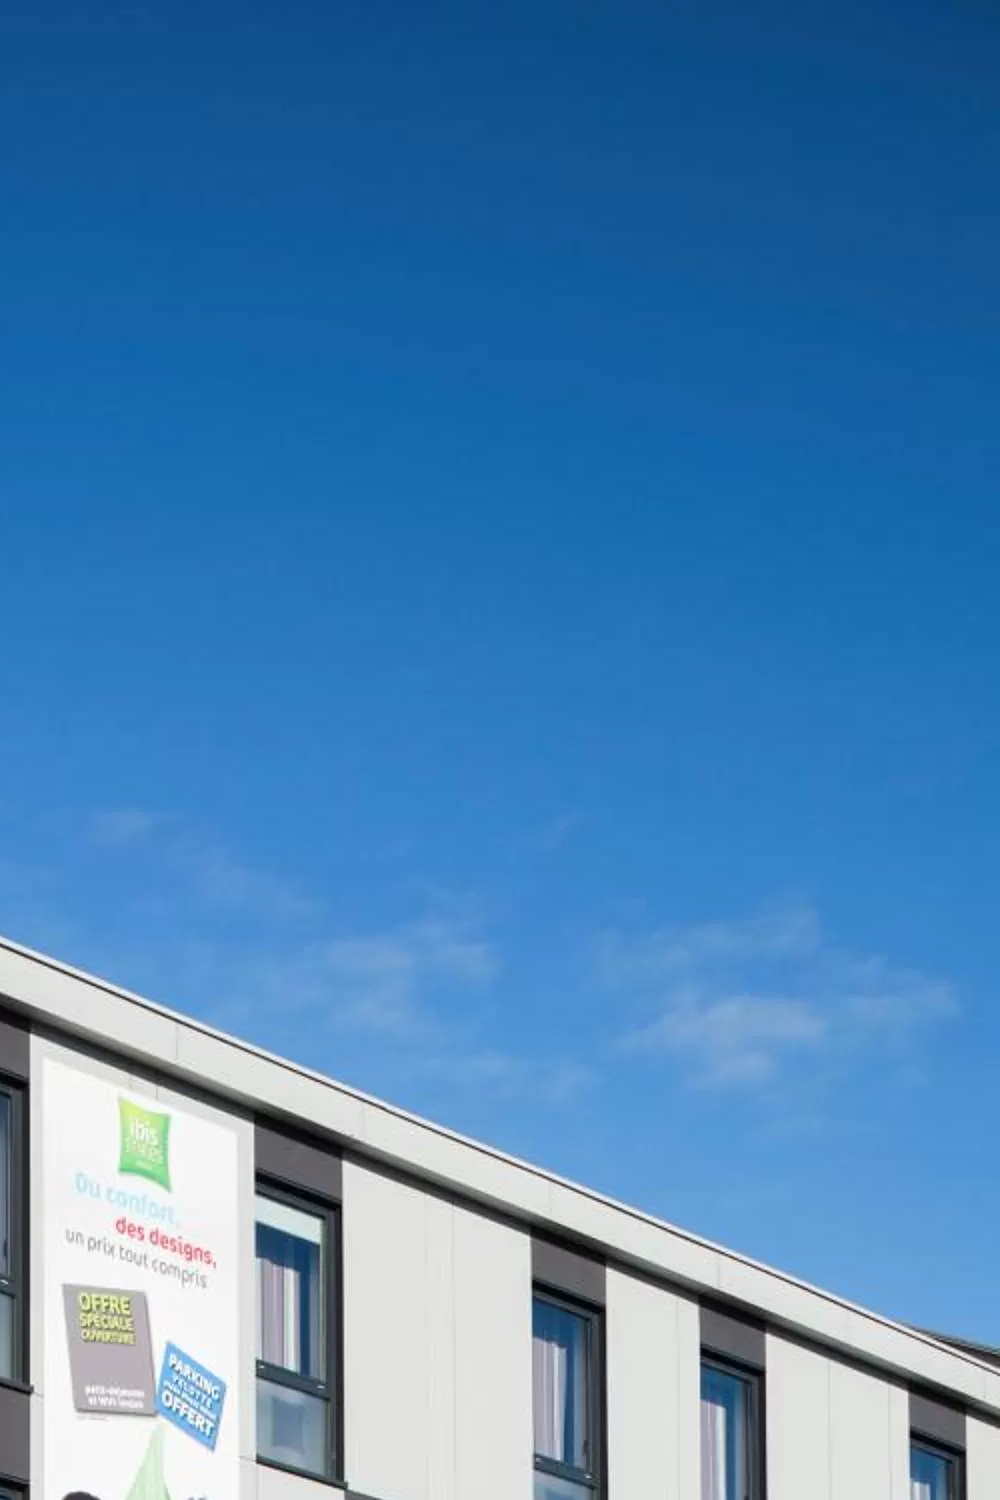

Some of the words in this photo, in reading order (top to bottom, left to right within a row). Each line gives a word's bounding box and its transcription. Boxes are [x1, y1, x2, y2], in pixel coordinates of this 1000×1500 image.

[74, 1172, 101, 1199] Du
[65, 1229, 85, 1245] un
[87, 1236, 115, 1260] prix
[119, 1245, 149, 1269] tout
[151, 1257, 208, 1290] compris
[115, 1216, 145, 1241] des
[149, 1228, 217, 1269] designs,
[79, 1292, 132, 1315] OFFRE
[169, 1353, 220, 1398] PARKING
[161, 1390, 216, 1437] OFFERT
